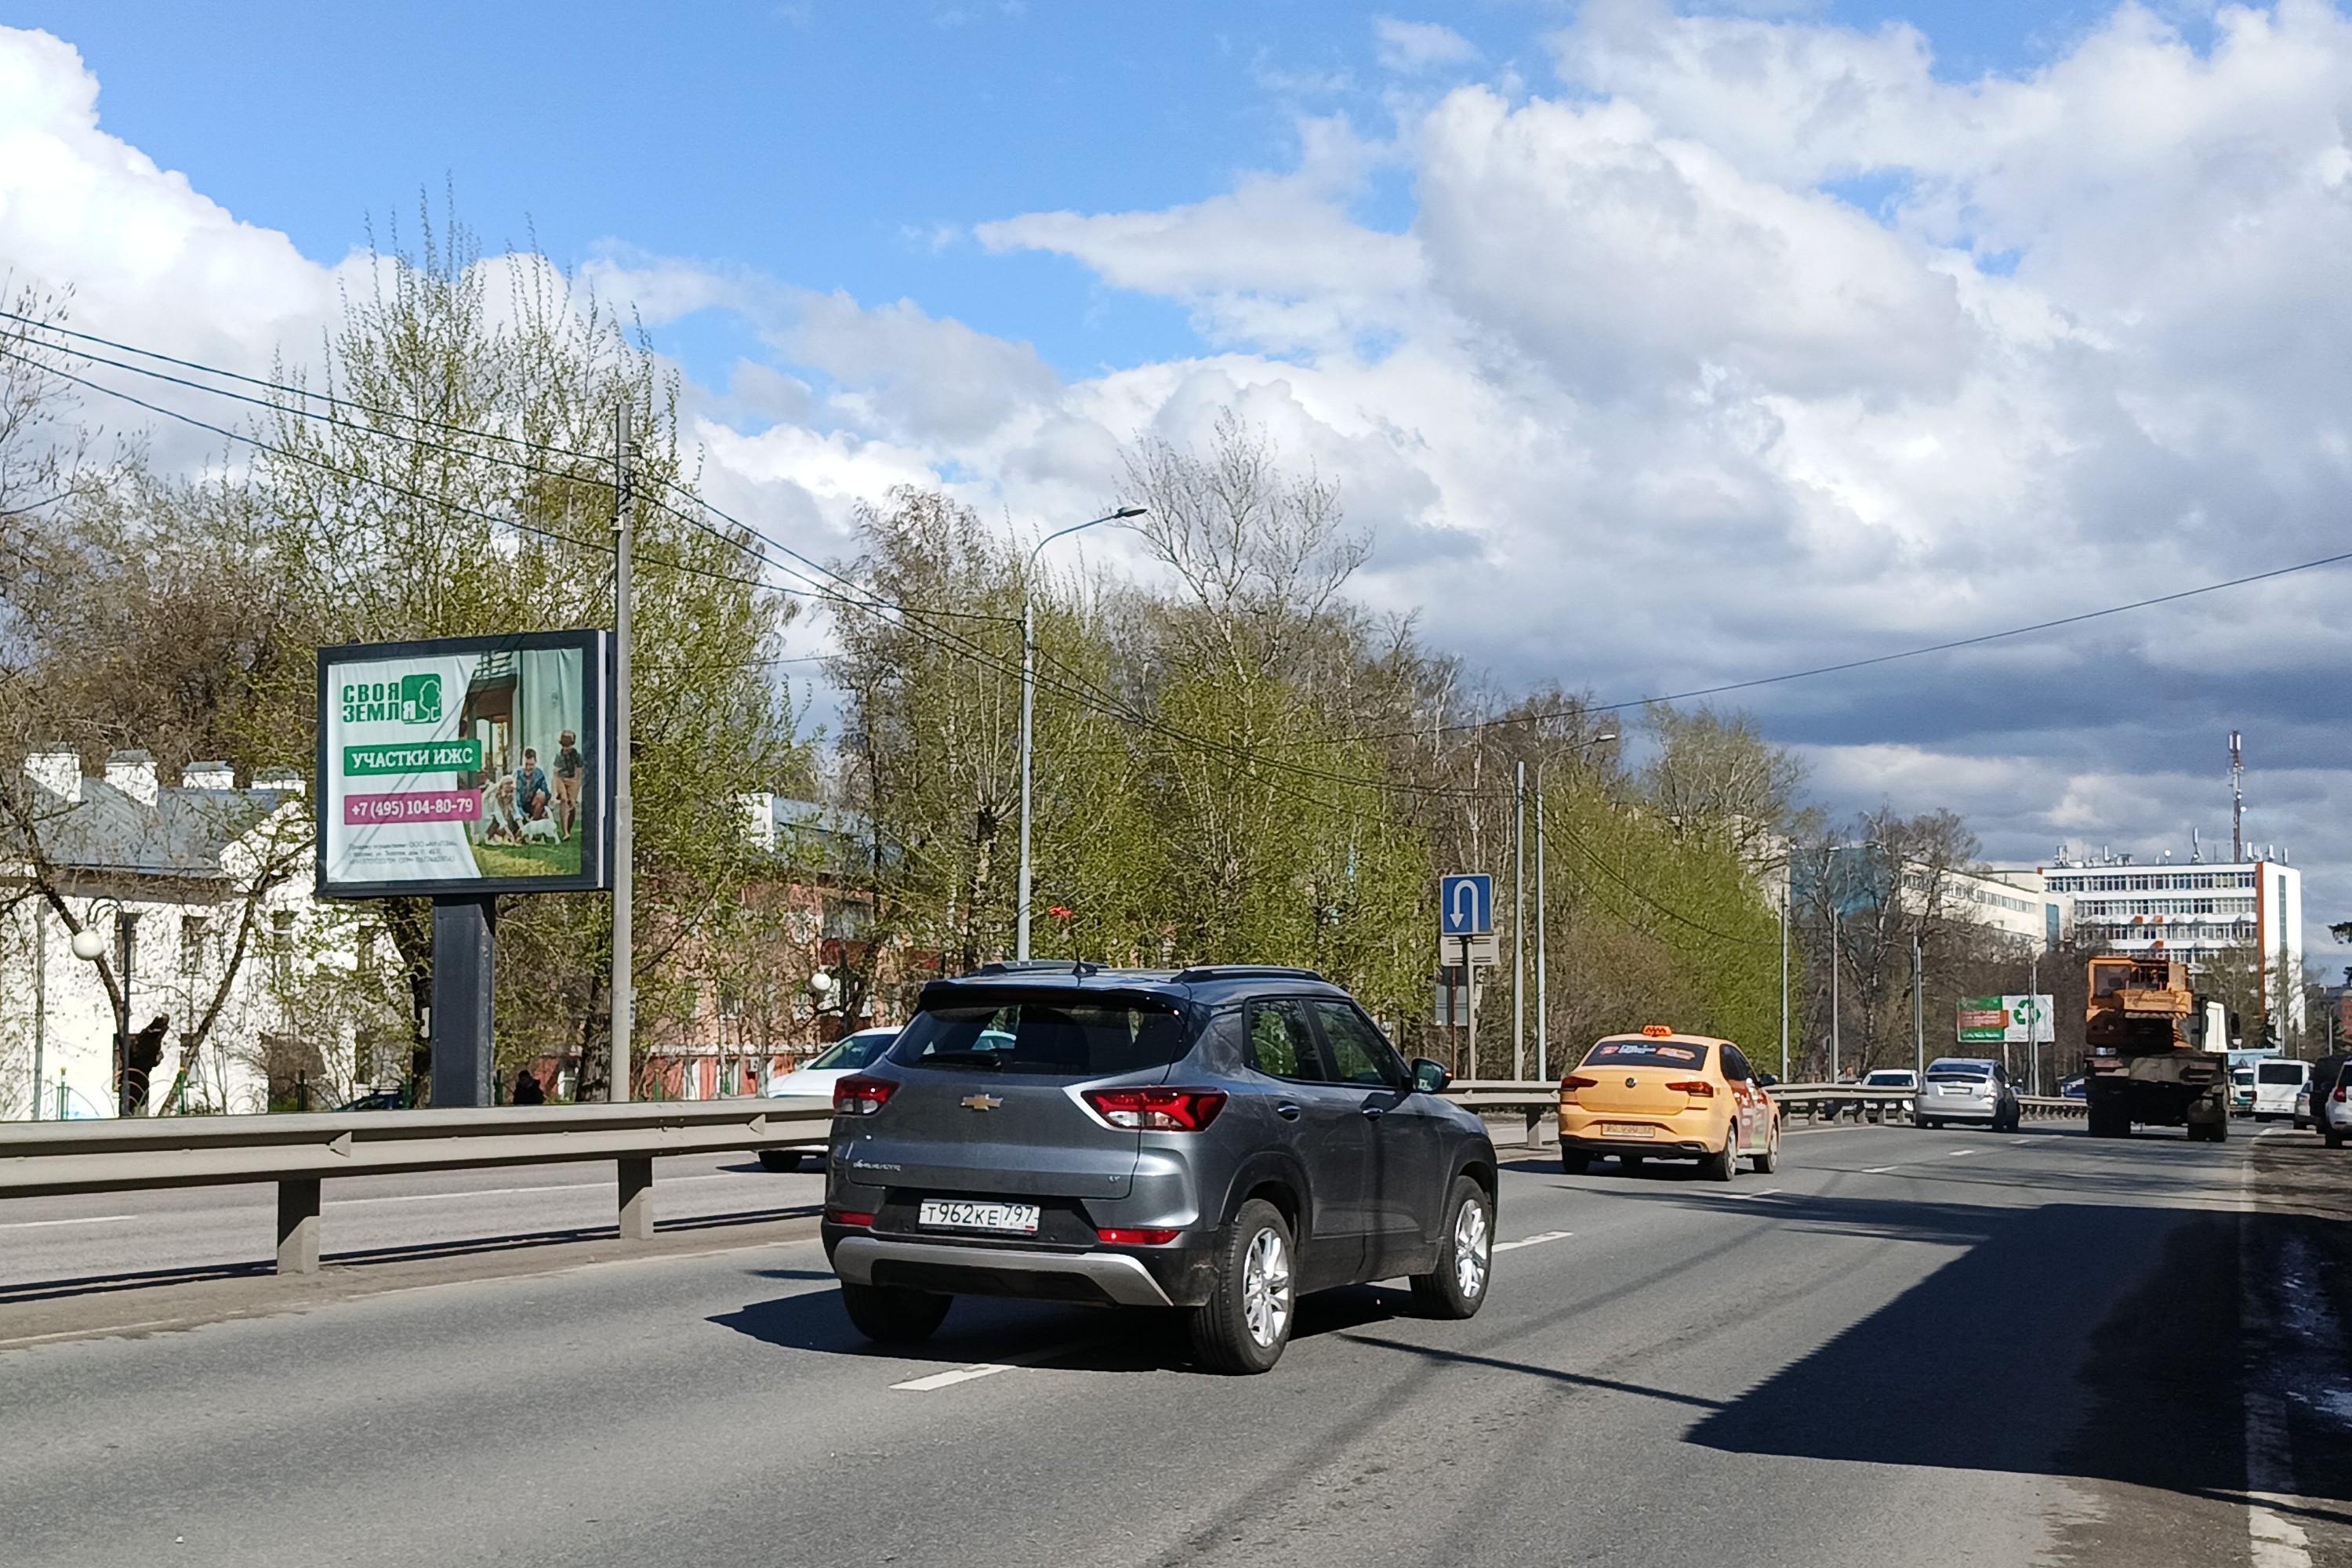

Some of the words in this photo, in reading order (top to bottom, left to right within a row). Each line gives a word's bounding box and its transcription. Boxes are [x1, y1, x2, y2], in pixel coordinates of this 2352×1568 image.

[343, 682, 400, 703] СВОЯ
[343, 700, 416, 723] ЗЕМЛЯ
[352, 750, 430, 769] УЧАСТКИ
[433, 748, 474, 764] ИЖС
[352, 802, 368, 816] +7
[370, 800, 405, 818] (495)
[407, 798, 474, 815] 104-80-79
[1004, 1205, 1033, 1222] 797
